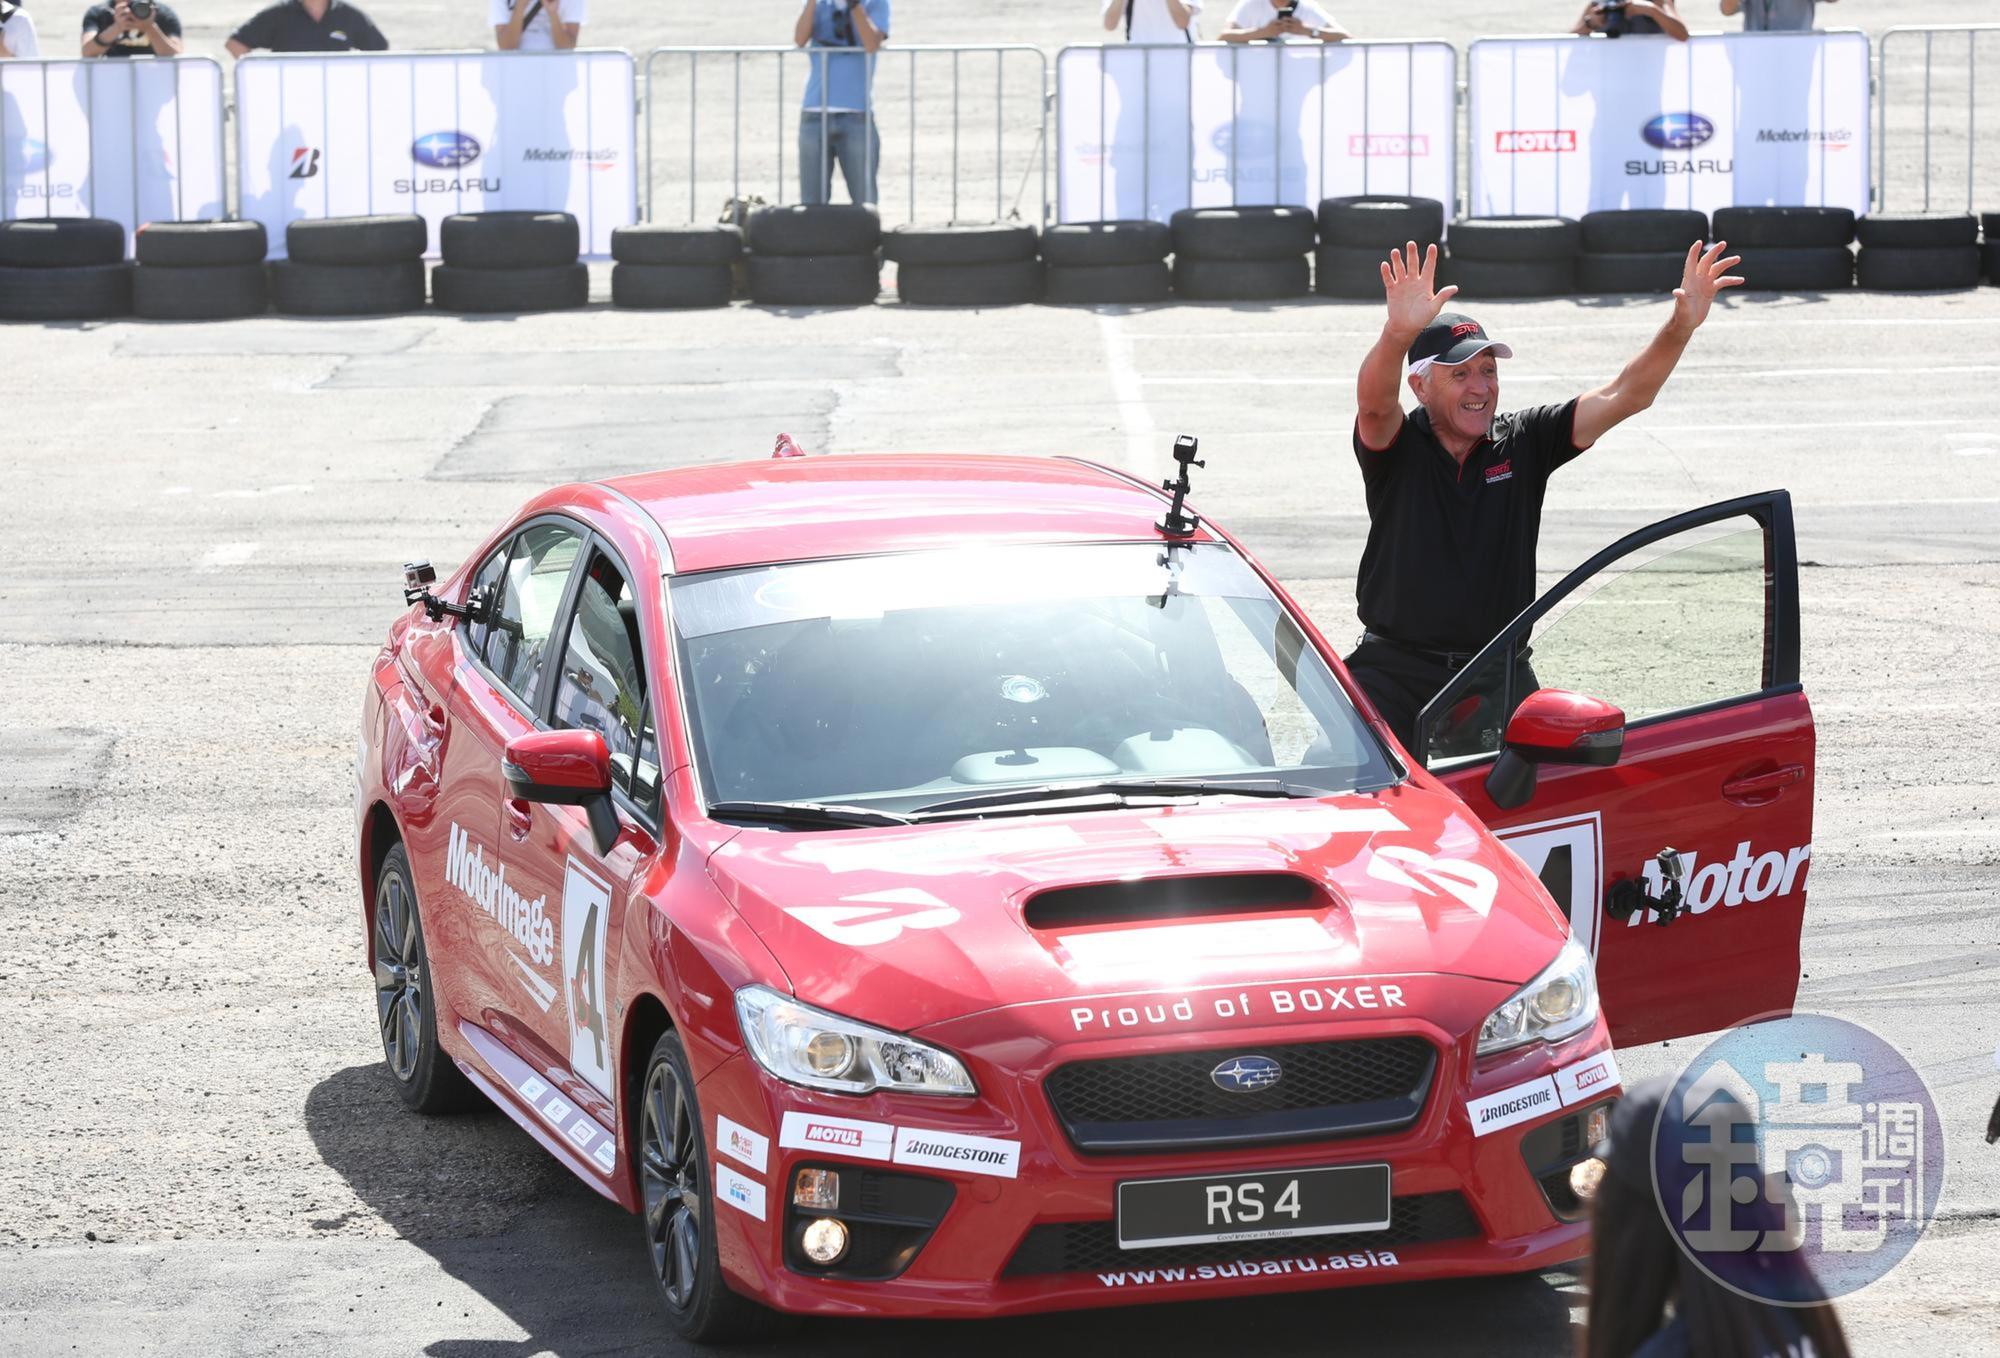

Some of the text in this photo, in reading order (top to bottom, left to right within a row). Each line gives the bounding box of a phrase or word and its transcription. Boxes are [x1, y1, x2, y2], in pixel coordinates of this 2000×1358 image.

[1500, 132, 1574, 151] MOTUL
[393, 178, 501, 193] SUBARU
[1625, 159, 1733, 176] SUBARU
[445, 821, 554, 967] MotorImage
[1627, 841, 1812, 928] Motor
[574, 902, 605, 1072] 4
[1070, 984, 1408, 1031] Proud of BOXER
[1480, 1064, 1608, 1123] BRIDGESTONE MOTUL
[807, 1125, 1009, 1165] MOTUL BRIDGESTONE
[1205, 1179, 1301, 1225] RS 4
[1097, 1250, 1399, 1288] www.subaru.asia
